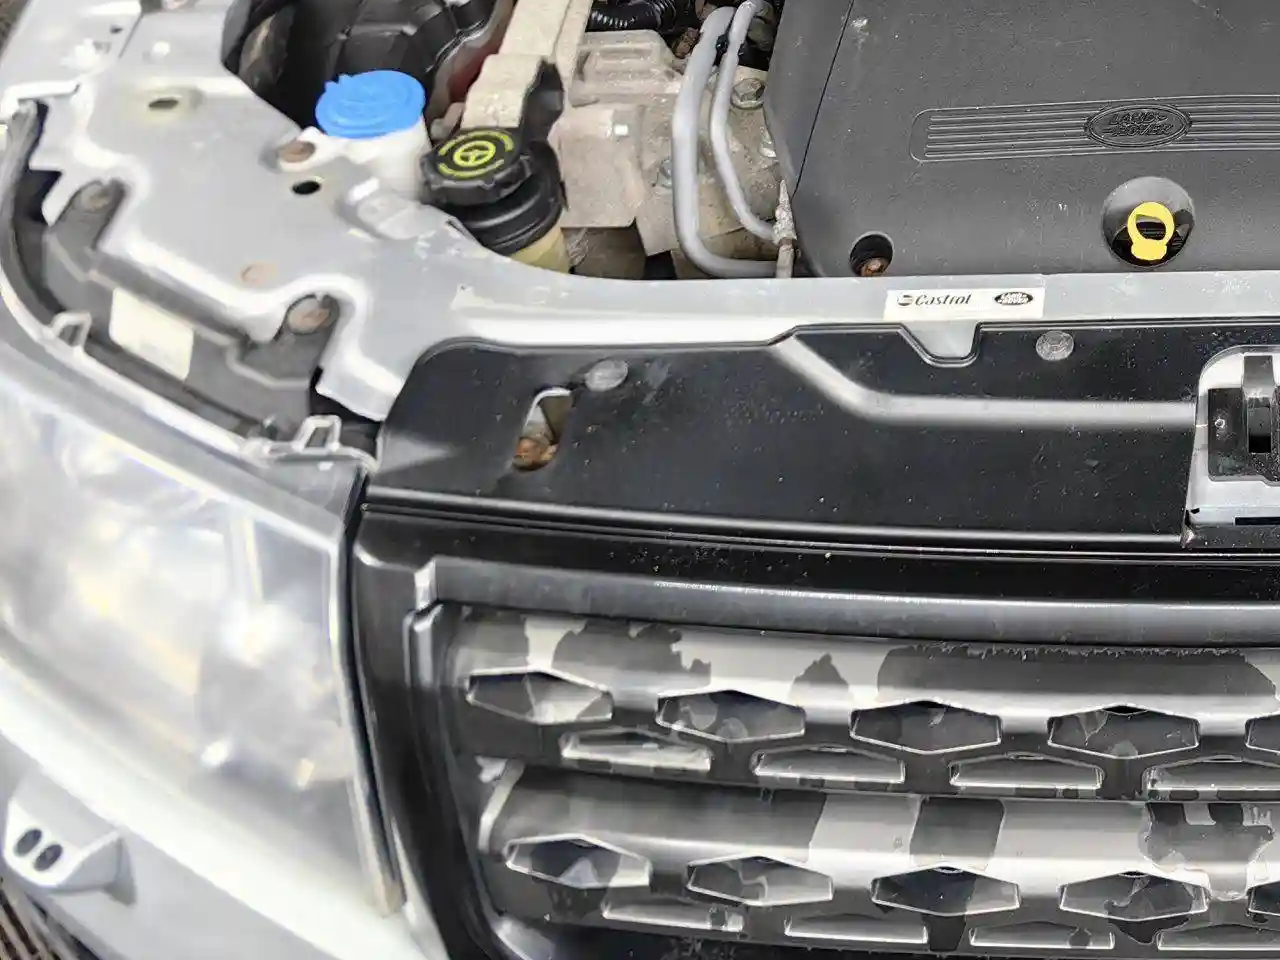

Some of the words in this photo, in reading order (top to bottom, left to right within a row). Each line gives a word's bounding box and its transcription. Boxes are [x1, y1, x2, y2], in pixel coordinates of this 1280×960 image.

[1109, 111, 1160, 125] LAND
[1112, 124, 1174, 137] ROVER
[915, 294, 972, 306] Castrol
